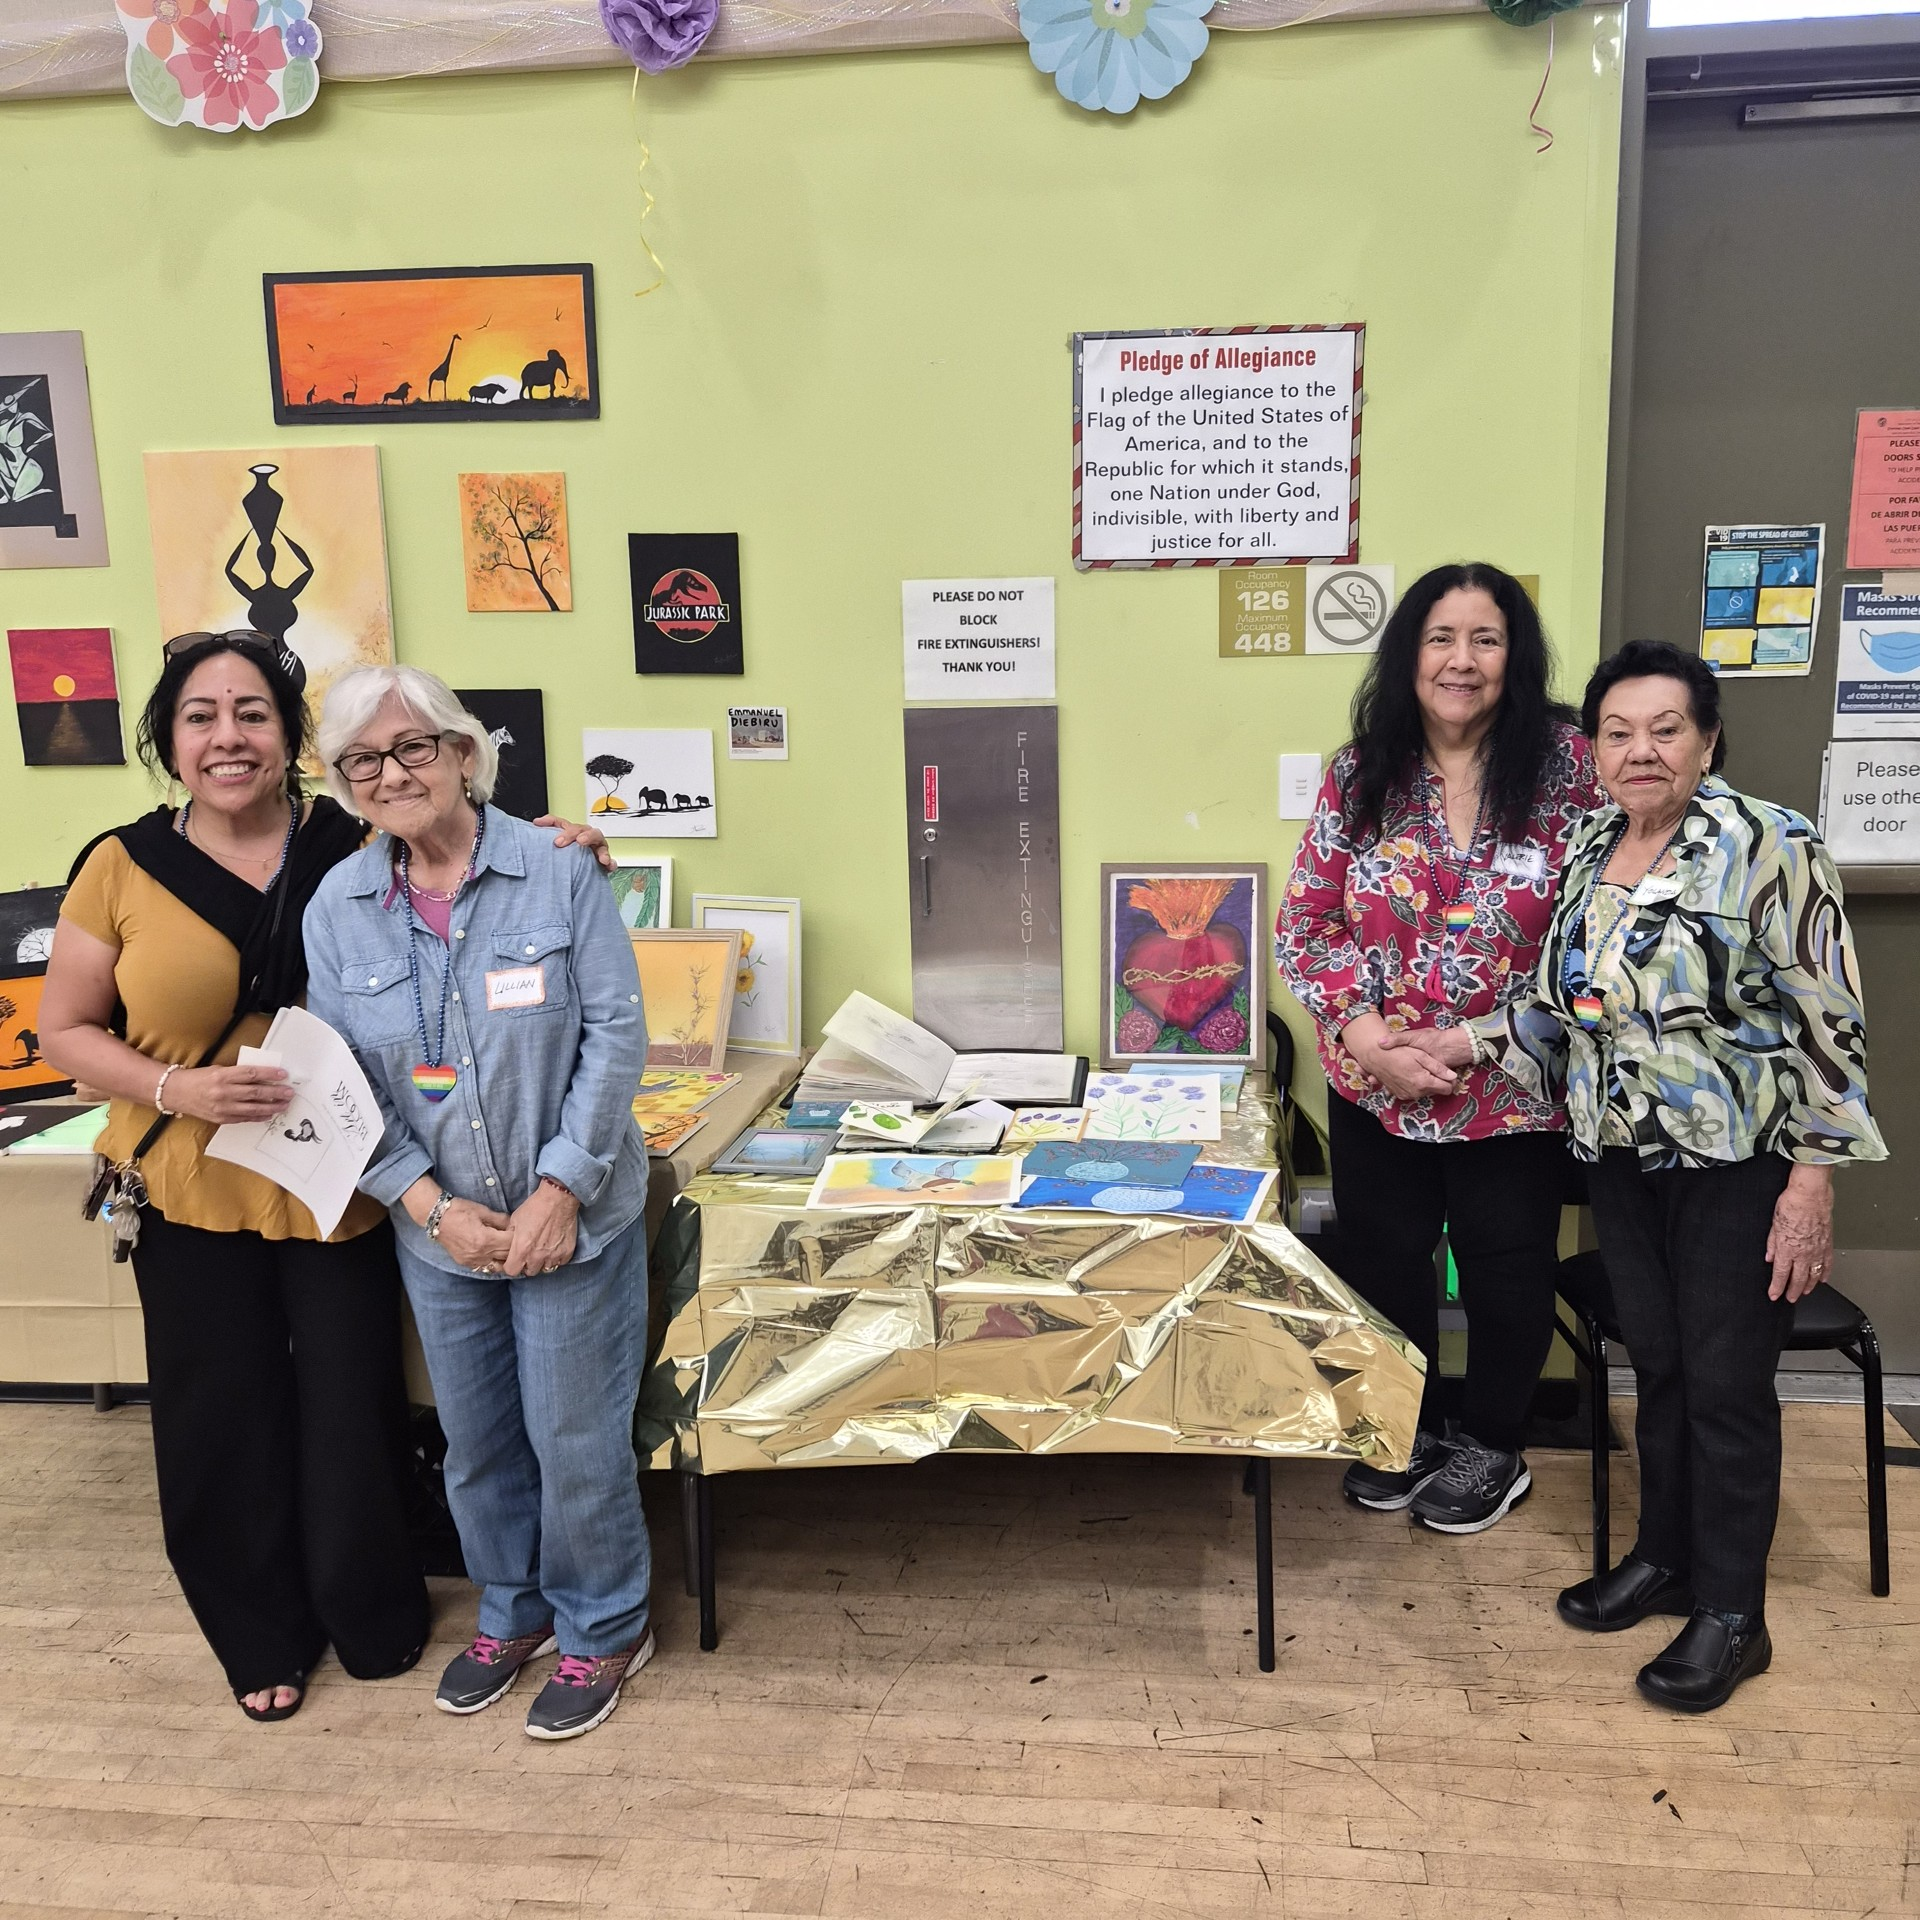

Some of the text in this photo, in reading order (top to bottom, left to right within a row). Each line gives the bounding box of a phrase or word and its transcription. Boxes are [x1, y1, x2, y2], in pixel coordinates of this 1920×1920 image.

[1120, 347, 1316, 376] Pledge of Allegiance
[1100, 382, 1336, 406] I pledge allegiance to the
[1087, 405, 1349, 431] Flag of the United States of
[1124, 433, 1308, 454] America, and to the
[1085, 456, 1349, 480] Republic for which it stands,
[1110, 482, 1321, 502] one Nation under God,
[1092, 506, 1339, 527] indivisible, with liberty and
[1151, 532, 1277, 553] justice for all.
[1248, 572, 1278, 580] Room
[1236, 580, 1290, 589] Occupancy
[933, 591, 1024, 602] PLEASE DO NOT
[1237, 590, 1289, 611] 126
[647, 606, 726, 620] JURASSIC PARK
[960, 615, 997, 625] BLOCK
[1238, 614, 1288, 622] Maximum
[1236, 623, 1290, 632] Occupancy
[918, 637, 1040, 649] FIRE EXTINGUISHERS!
[1235, 632, 1291, 653] 448
[942, 661, 1015, 672] THANK YOU!
[729, 708, 782, 717] EMMANUEL
[731, 717, 778, 727] DIEBIRU
[1017, 731, 1028, 802] FIRE
[1857, 761, 1920, 777] Please
[1843, 789, 1920, 805] use othe
[1863, 817, 1907, 832] door
[495, 979, 535, 994] LILLIAN
